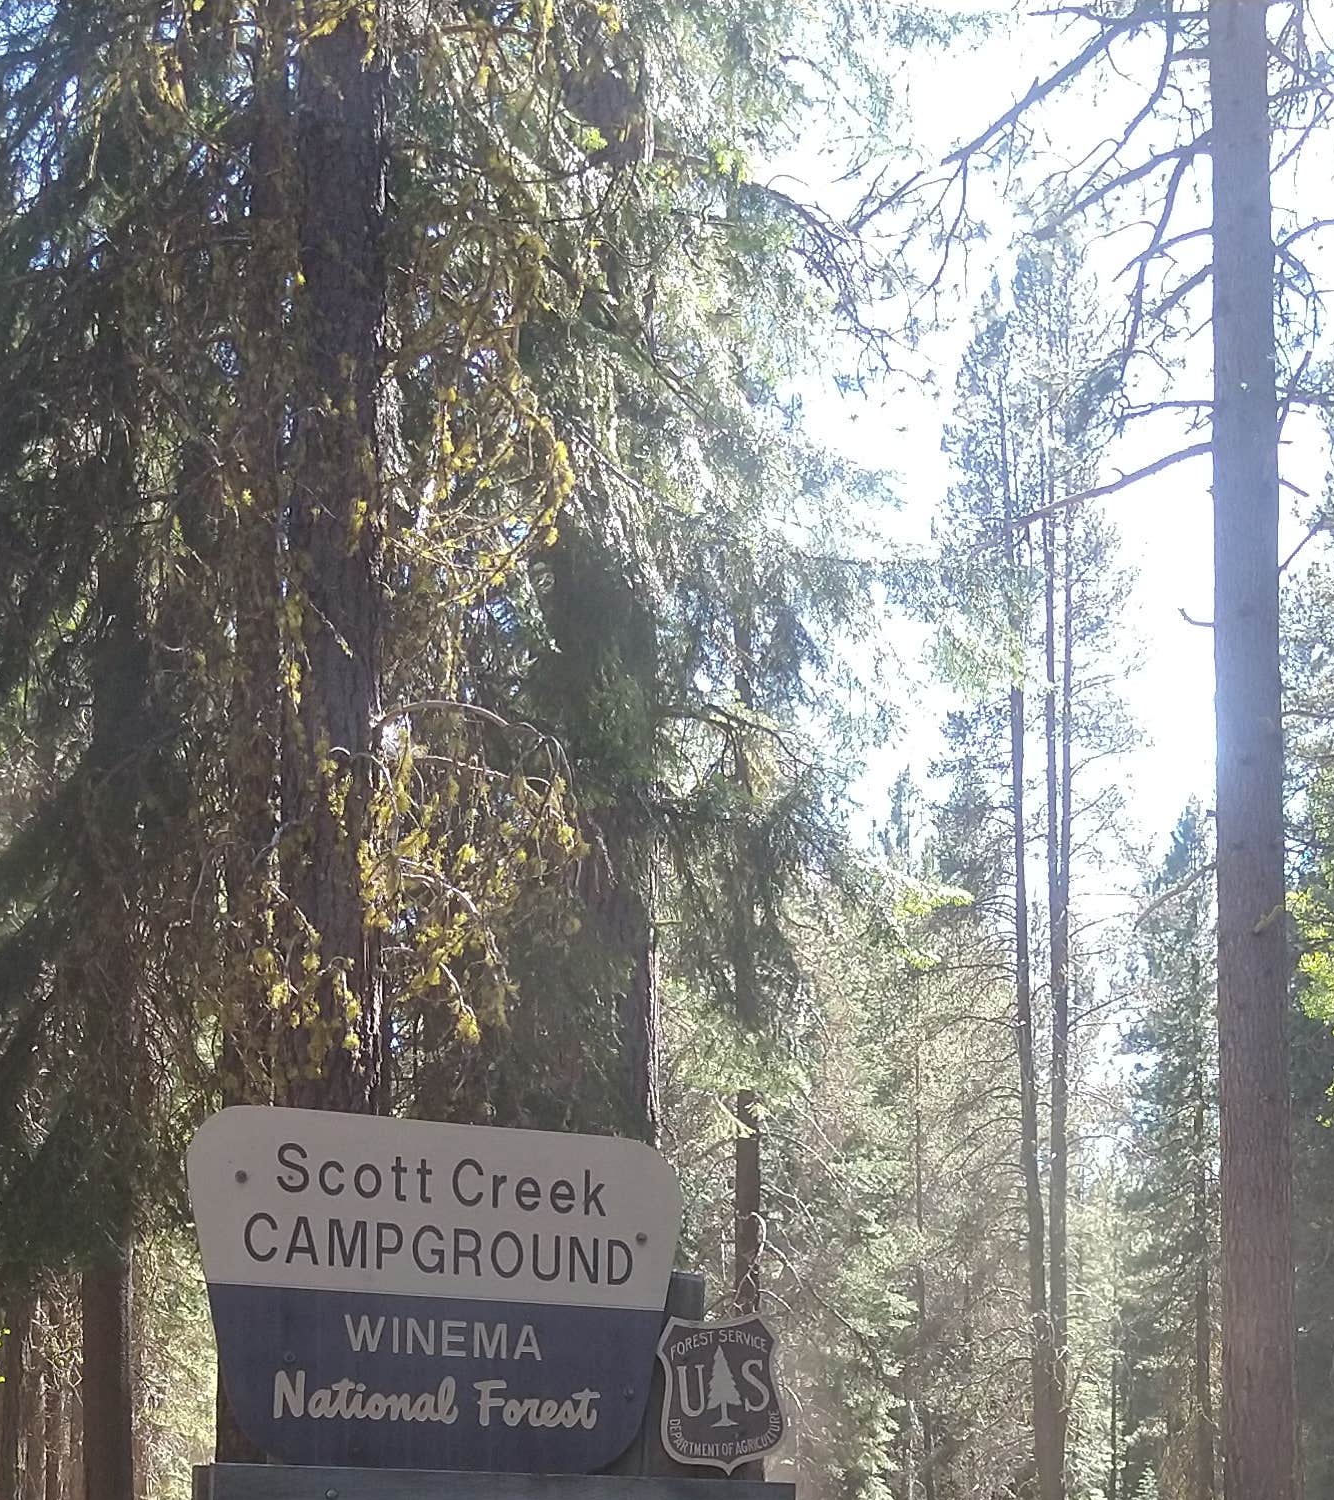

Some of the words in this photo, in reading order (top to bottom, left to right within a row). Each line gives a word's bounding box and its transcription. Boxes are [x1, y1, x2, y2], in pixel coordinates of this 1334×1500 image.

[276, 1142, 432, 1203] Scott
[452, 1158, 606, 1217] Creek
[244, 1212, 633, 1286] CAMPGROUND
[344, 1314, 542, 1361] WINEMA
[670, 1331, 714, 1361] FOREST
[718, 1329, 767, 1353] SERVICE
[273, 1370, 458, 1425] National
[473, 1379, 601, 1430] Forest
[669, 1418, 719, 1457] DEPARTMENT
[722, 1445, 735, 1456] OF
[735, 1410, 781, 1456] AGRICULTURE
